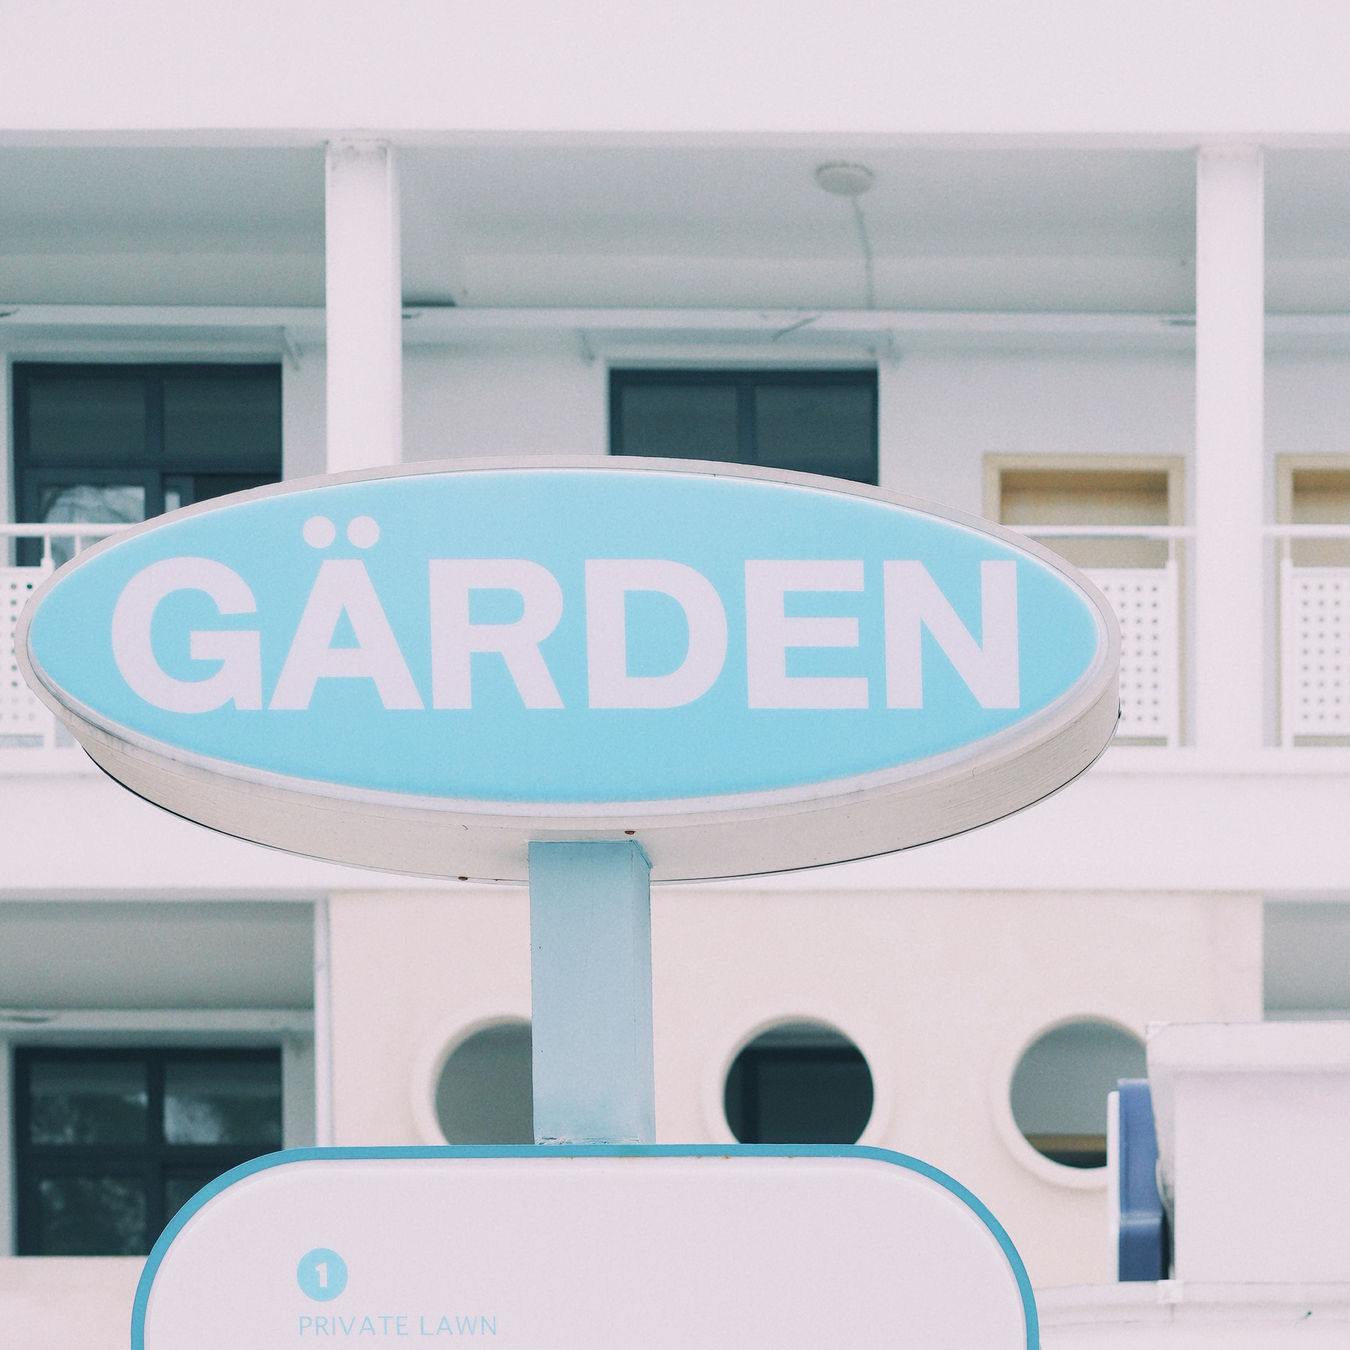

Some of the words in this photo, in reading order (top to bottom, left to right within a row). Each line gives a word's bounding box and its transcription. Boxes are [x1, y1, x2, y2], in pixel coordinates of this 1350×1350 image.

[110, 515, 1021, 714] GÄRDEN
[298, 1315, 409, 1337] PRIVATE
[419, 1315, 498, 1337] LAWN
